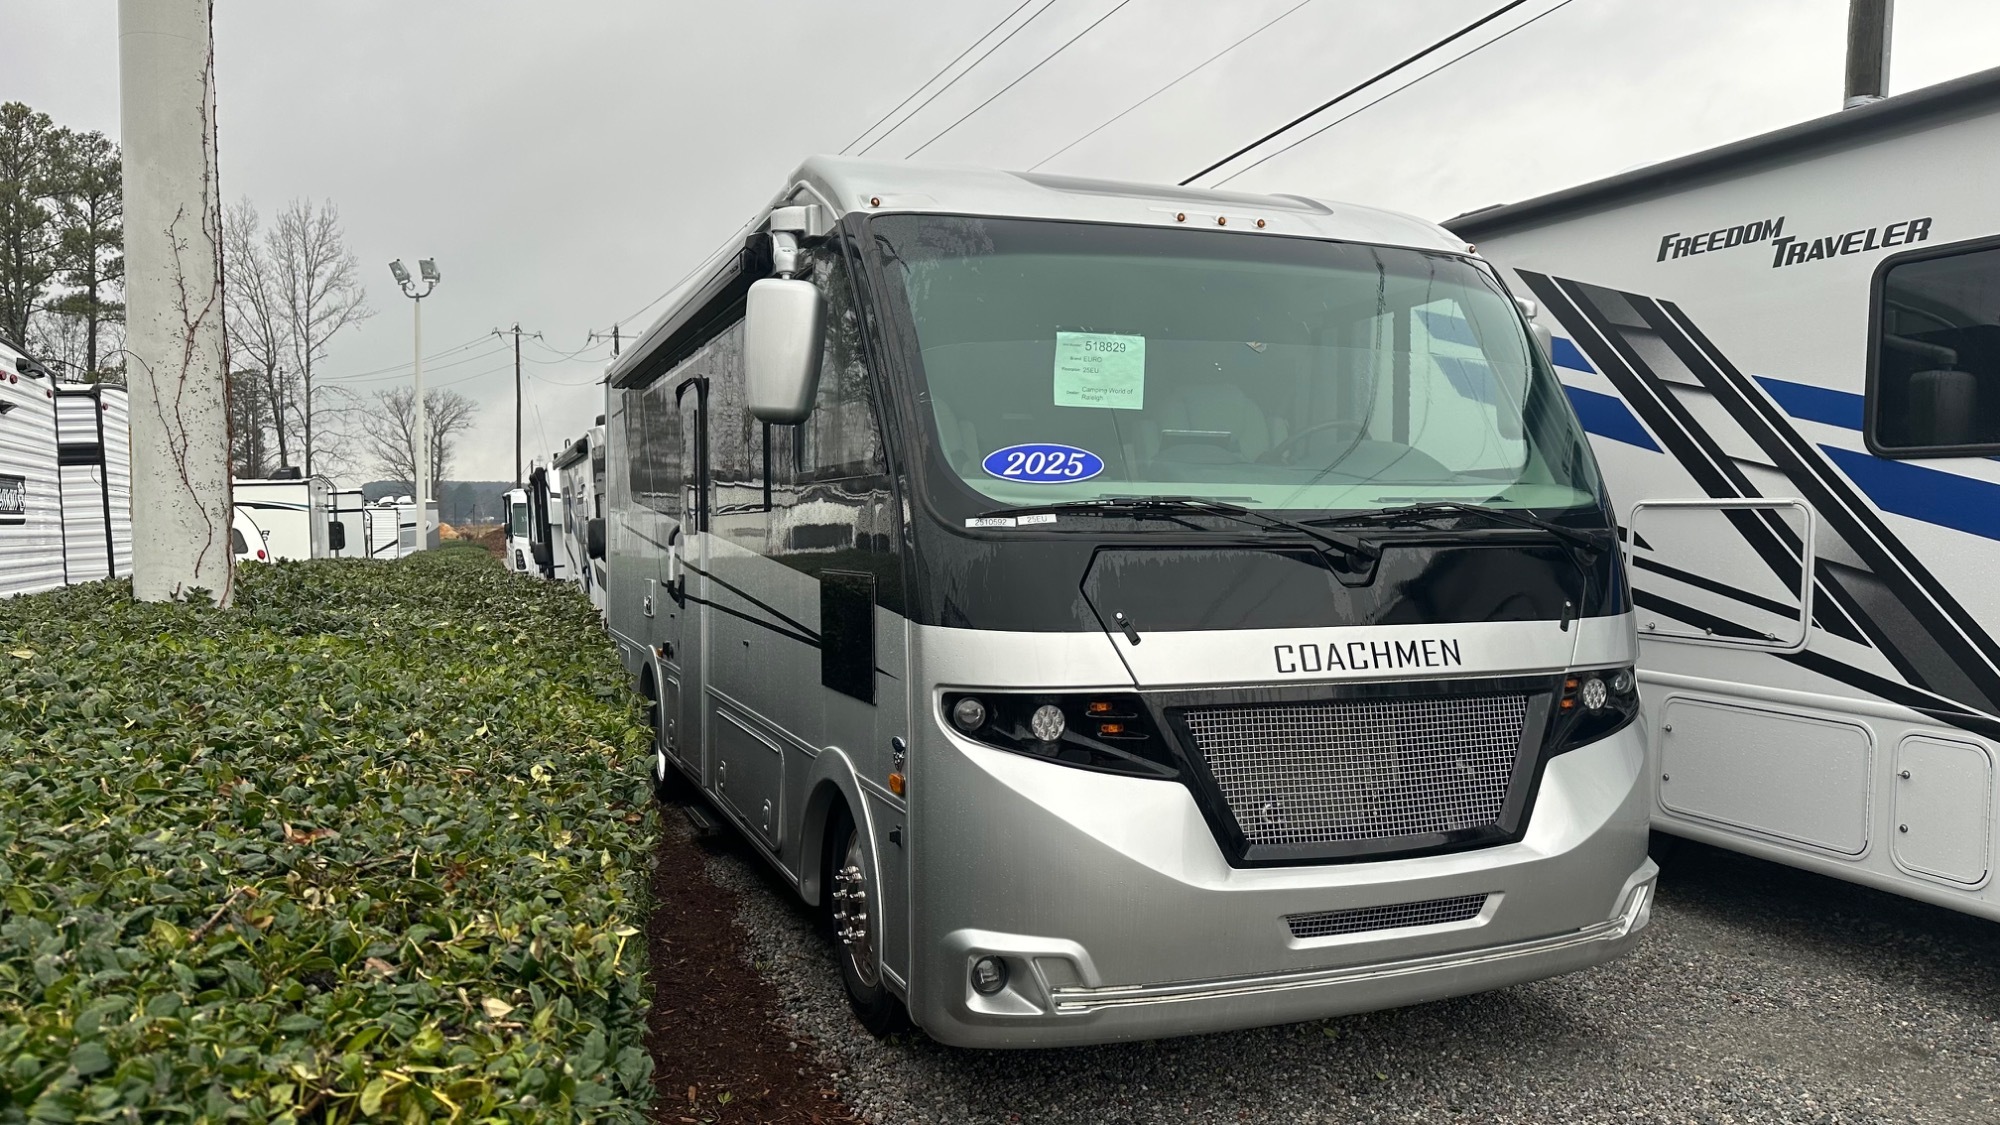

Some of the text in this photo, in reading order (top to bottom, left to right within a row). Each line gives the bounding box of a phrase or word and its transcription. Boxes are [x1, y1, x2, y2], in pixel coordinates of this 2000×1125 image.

[1656, 215, 1785, 263] FREEDOM
[1772, 216, 1932, 268] TRAVELER
[1085, 340, 1126, 353] 518829
[1081, 394, 1104, 402] Raleigh
[1082, 386, 1108, 394] Camping
[1003, 451, 1086, 477] 2025
[974, 515, 1048, 526] 2510592 25EU
[1274, 638, 1461, 674] COACHMEN
